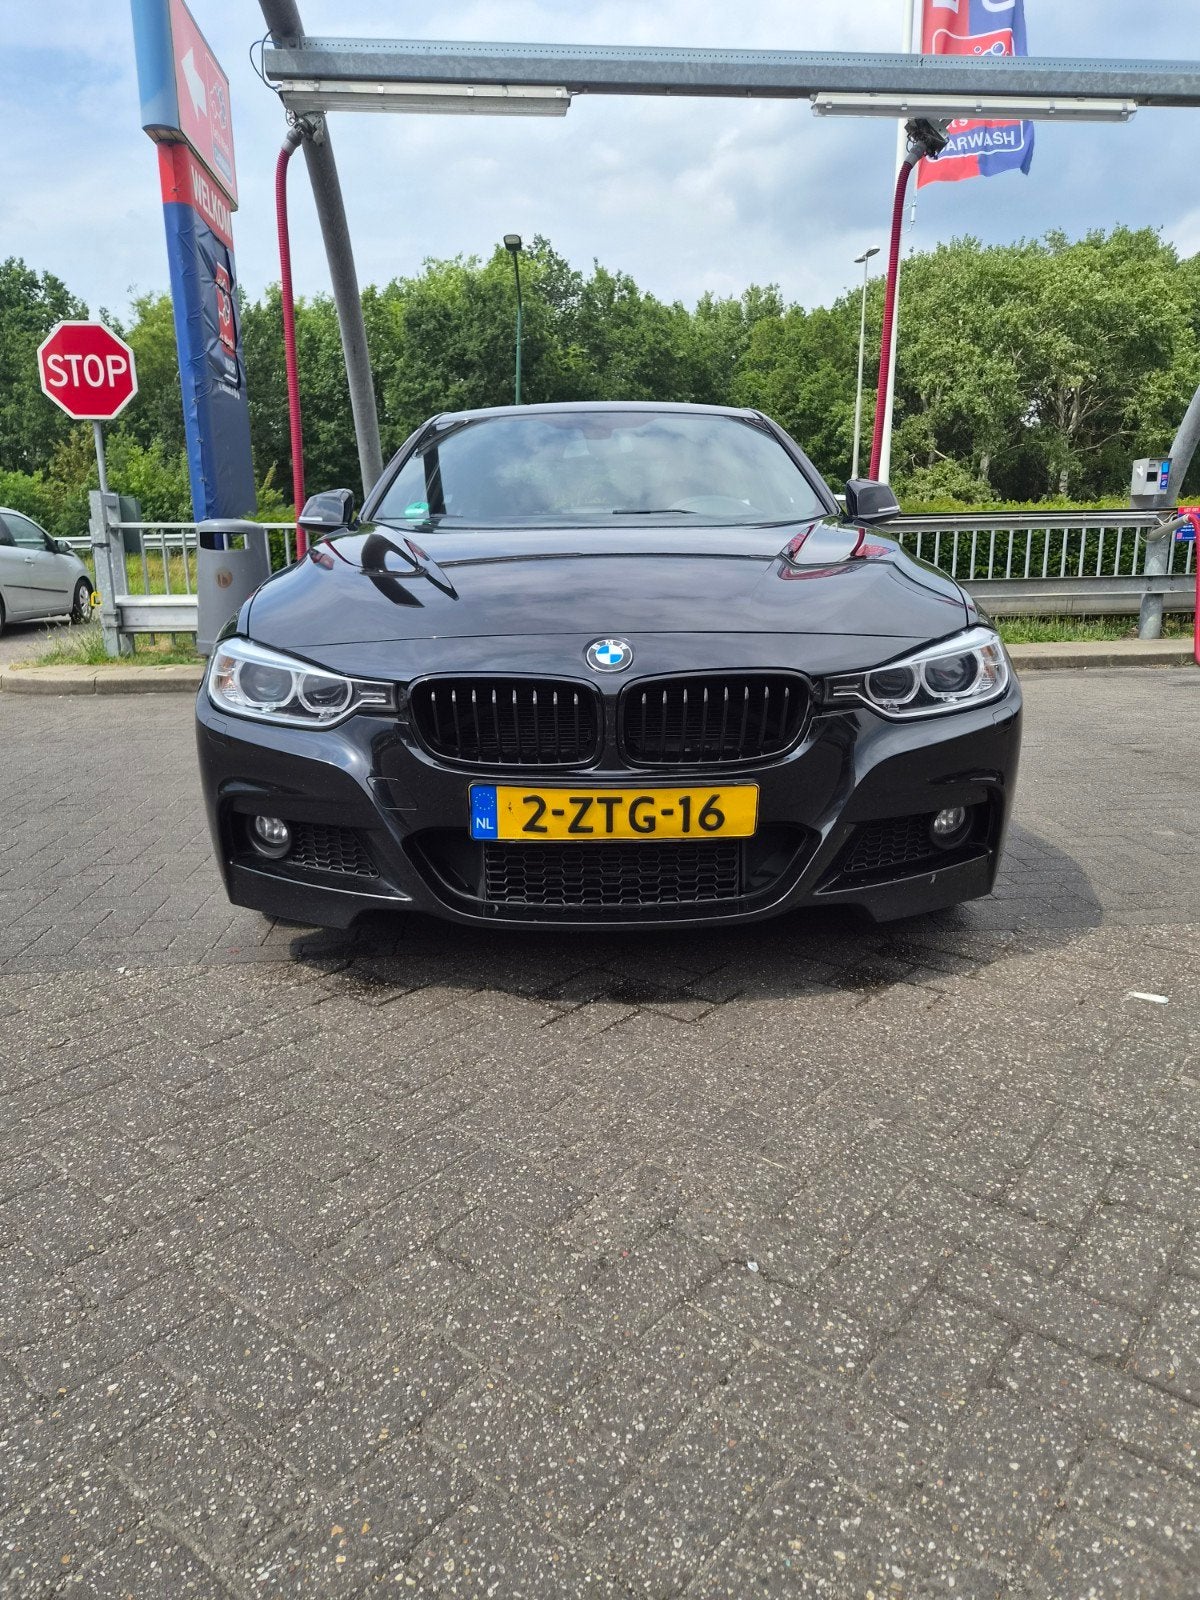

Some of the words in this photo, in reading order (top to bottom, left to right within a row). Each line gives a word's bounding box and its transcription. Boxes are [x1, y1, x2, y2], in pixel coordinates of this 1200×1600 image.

[945, 130, 1015, 152] ARWASH
[46, 353, 128, 388] STOP
[590, 639, 629, 650] BMW
[476, 817, 494, 830] NL
[521, 794, 726, 834] 2-ZTG-16
